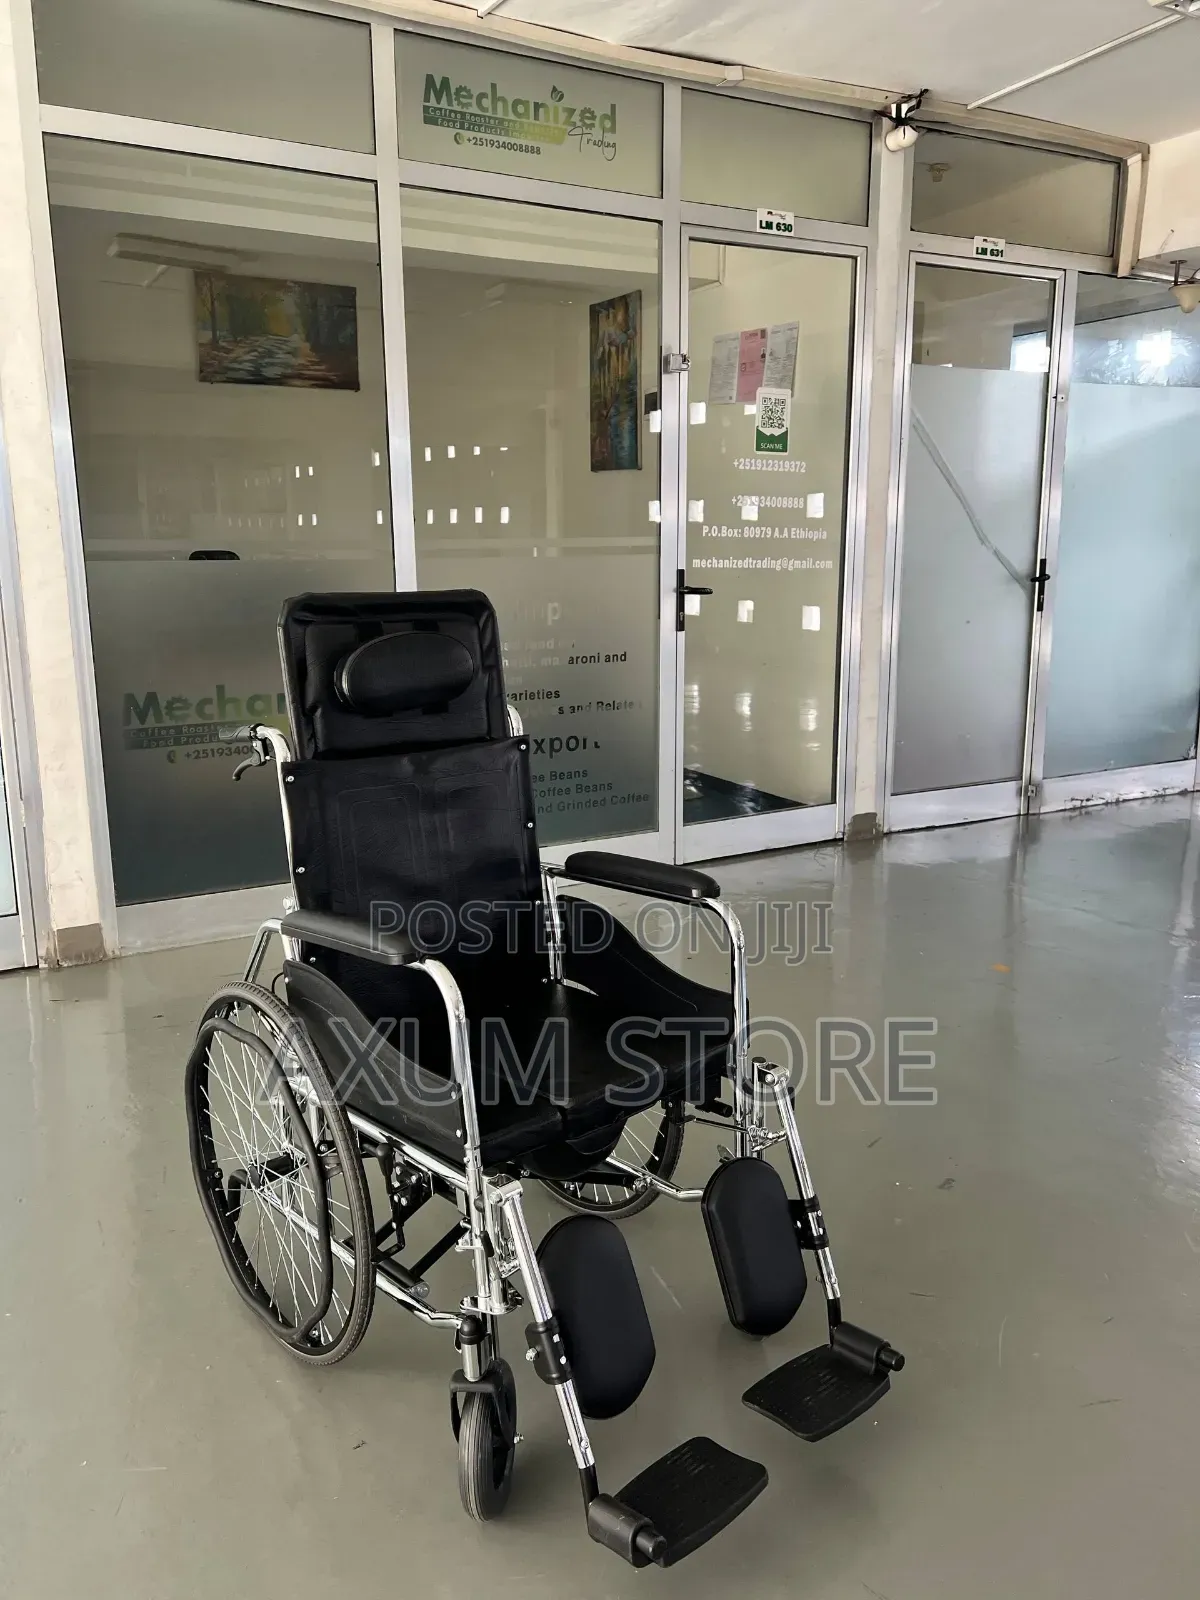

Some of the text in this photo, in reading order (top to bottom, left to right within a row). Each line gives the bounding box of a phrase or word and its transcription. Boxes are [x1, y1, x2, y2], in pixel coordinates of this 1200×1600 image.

[423, 74, 616, 135] Mechanized
[429, 108, 461, 119] Coffee
[465, 113, 499, 125] Roaster
[438, 119, 460, 129] Food
[464, 123, 505, 136] Products
[466, 137, 541, 155] +251934008888
[759, 220, 793, 233] LM 630
[976, 247, 1004, 257] LM 631
[733, 458, 806, 473] +251912319372
[702, 526, 827, 541] P.O.Box: 80979 A.A Ethiopia
[692, 557, 833, 571] mechanizedtrading@gmail.com
[604, 650, 628, 663] and
[569, 702, 592, 714] and
[596, 699, 642, 712] Relate
[130, 727, 176, 738] Coffee
[143, 734, 221, 748] Food Produ
[549, 769, 588, 781] Beans
[575, 782, 613, 794] Beans
[557, 797, 607, 812] Grinded
[610, 792, 650, 805] Coffee
